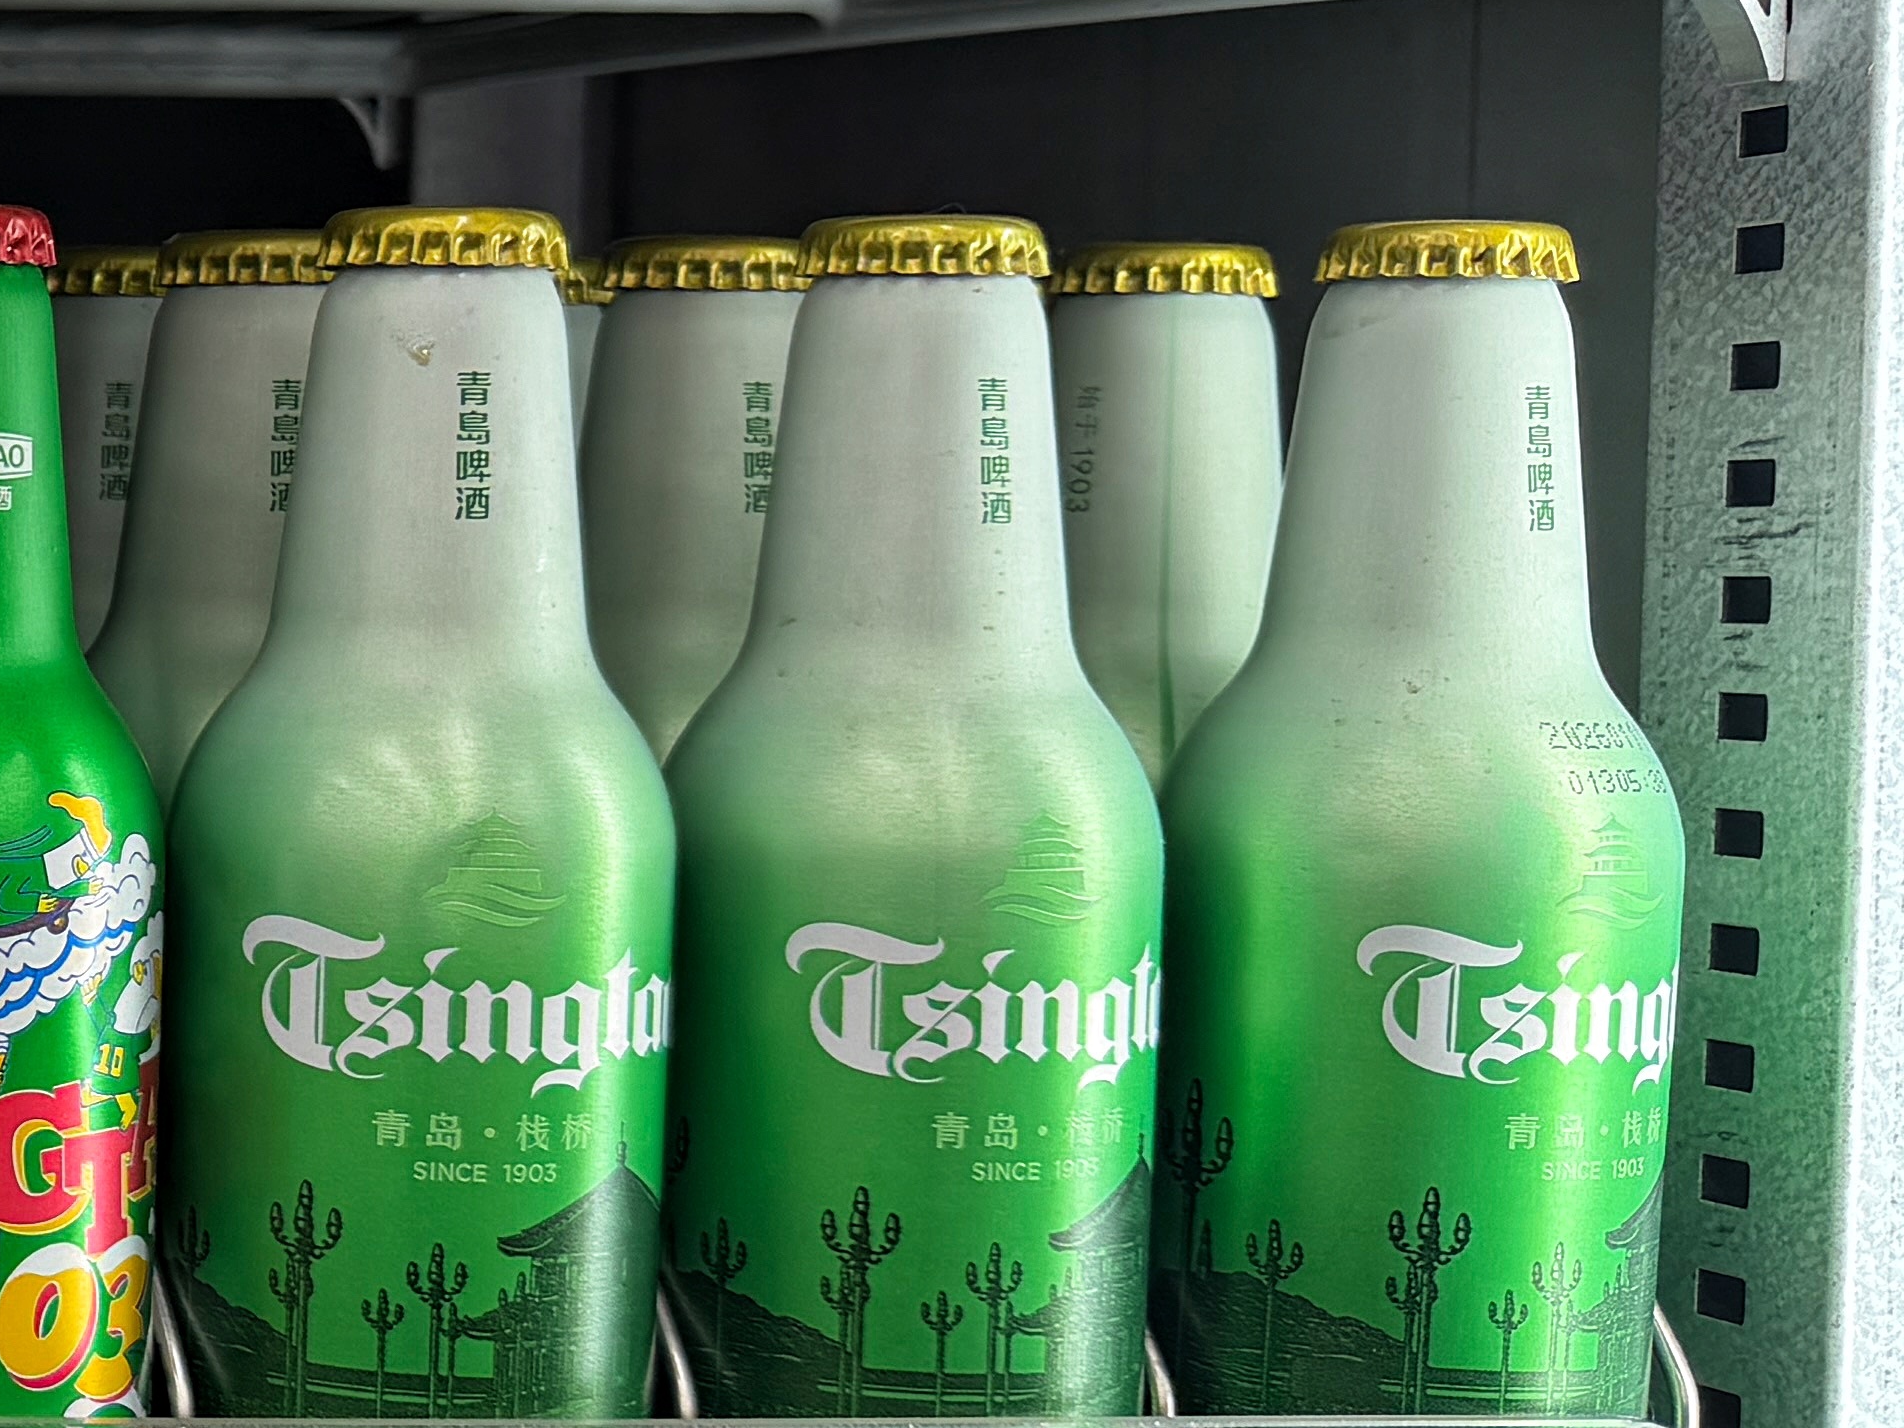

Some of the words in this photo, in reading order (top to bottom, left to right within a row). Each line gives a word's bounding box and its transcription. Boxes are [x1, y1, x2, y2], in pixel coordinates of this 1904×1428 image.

[412, 1160, 488, 1184] SINCE
[502, 1160, 558, 1186] 1903
[969, 1160, 1042, 1184] SINCE
